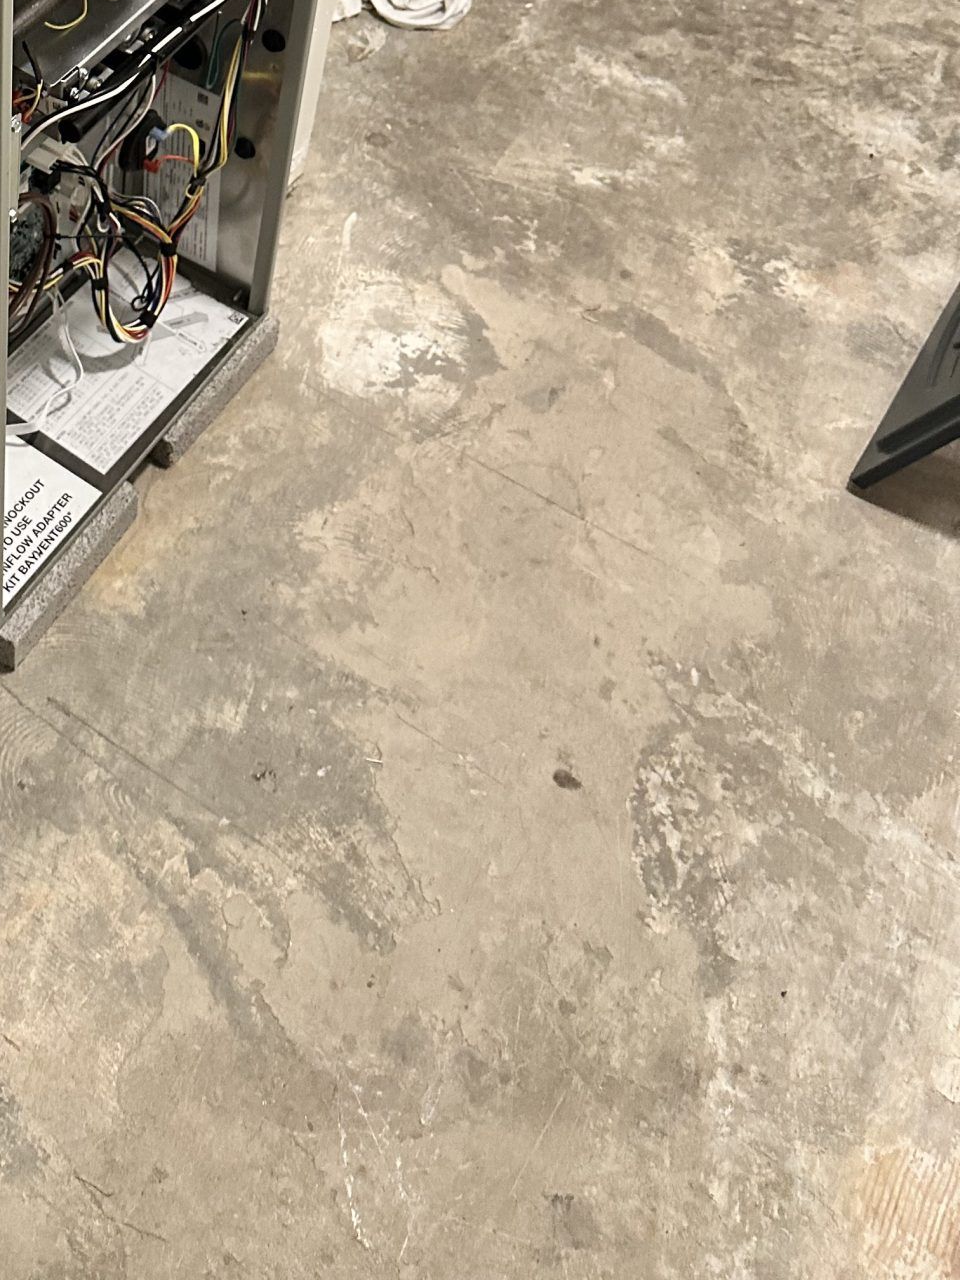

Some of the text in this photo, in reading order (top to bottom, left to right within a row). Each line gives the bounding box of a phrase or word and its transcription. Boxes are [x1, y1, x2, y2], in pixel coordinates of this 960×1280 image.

[1, 478, 45, 528] NOCKOUT
[31, 491, 73, 537] ADAPTER
[10, 513, 33, 537] USE
[2, 572, 21, 593] KIT
